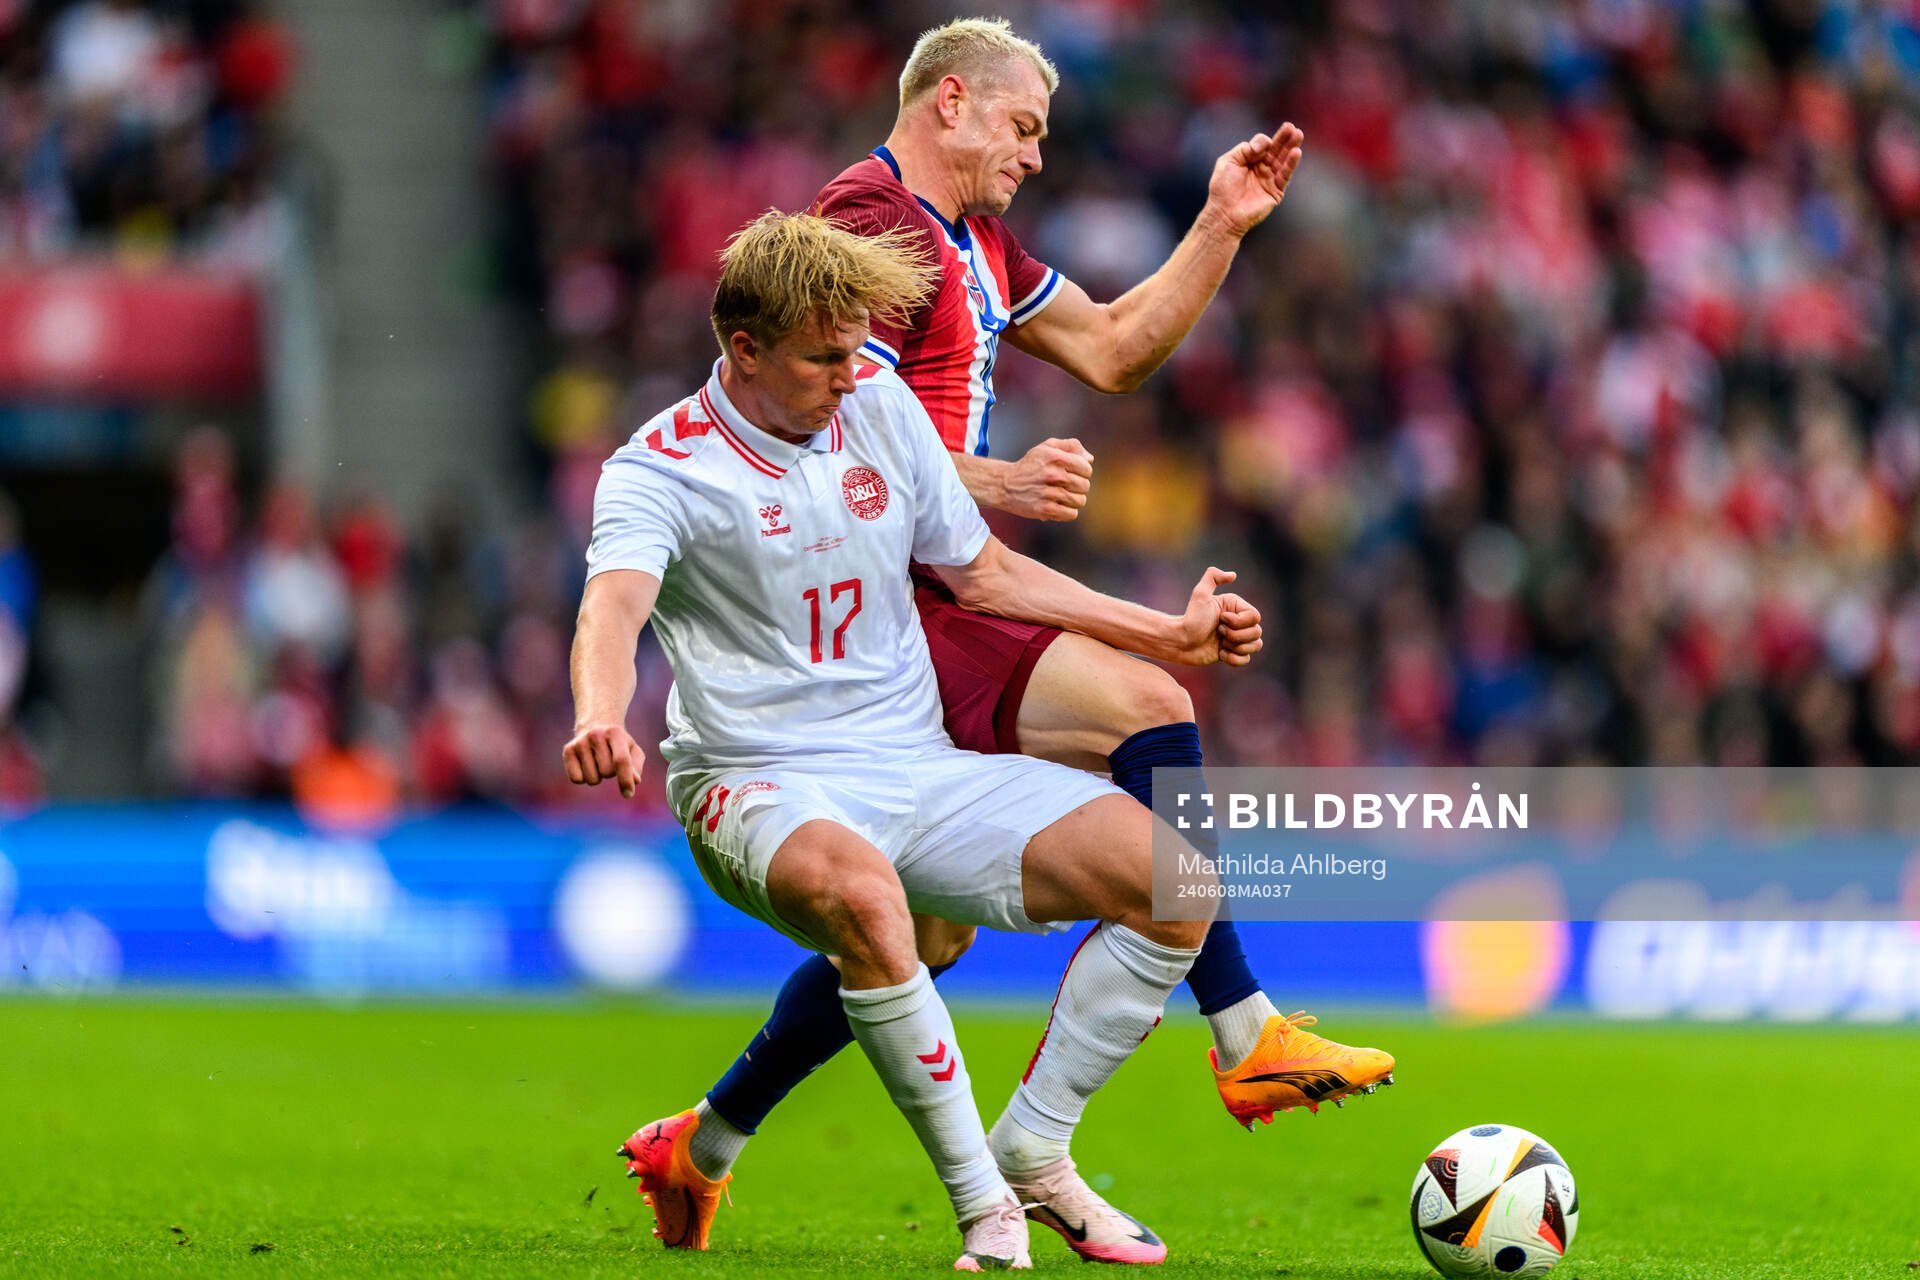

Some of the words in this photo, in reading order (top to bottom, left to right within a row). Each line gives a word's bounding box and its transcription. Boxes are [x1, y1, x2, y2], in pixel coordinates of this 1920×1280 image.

[849, 482, 879, 502] DBU
[761, 523, 791, 537] hummel
[803, 577, 862, 664] 17
